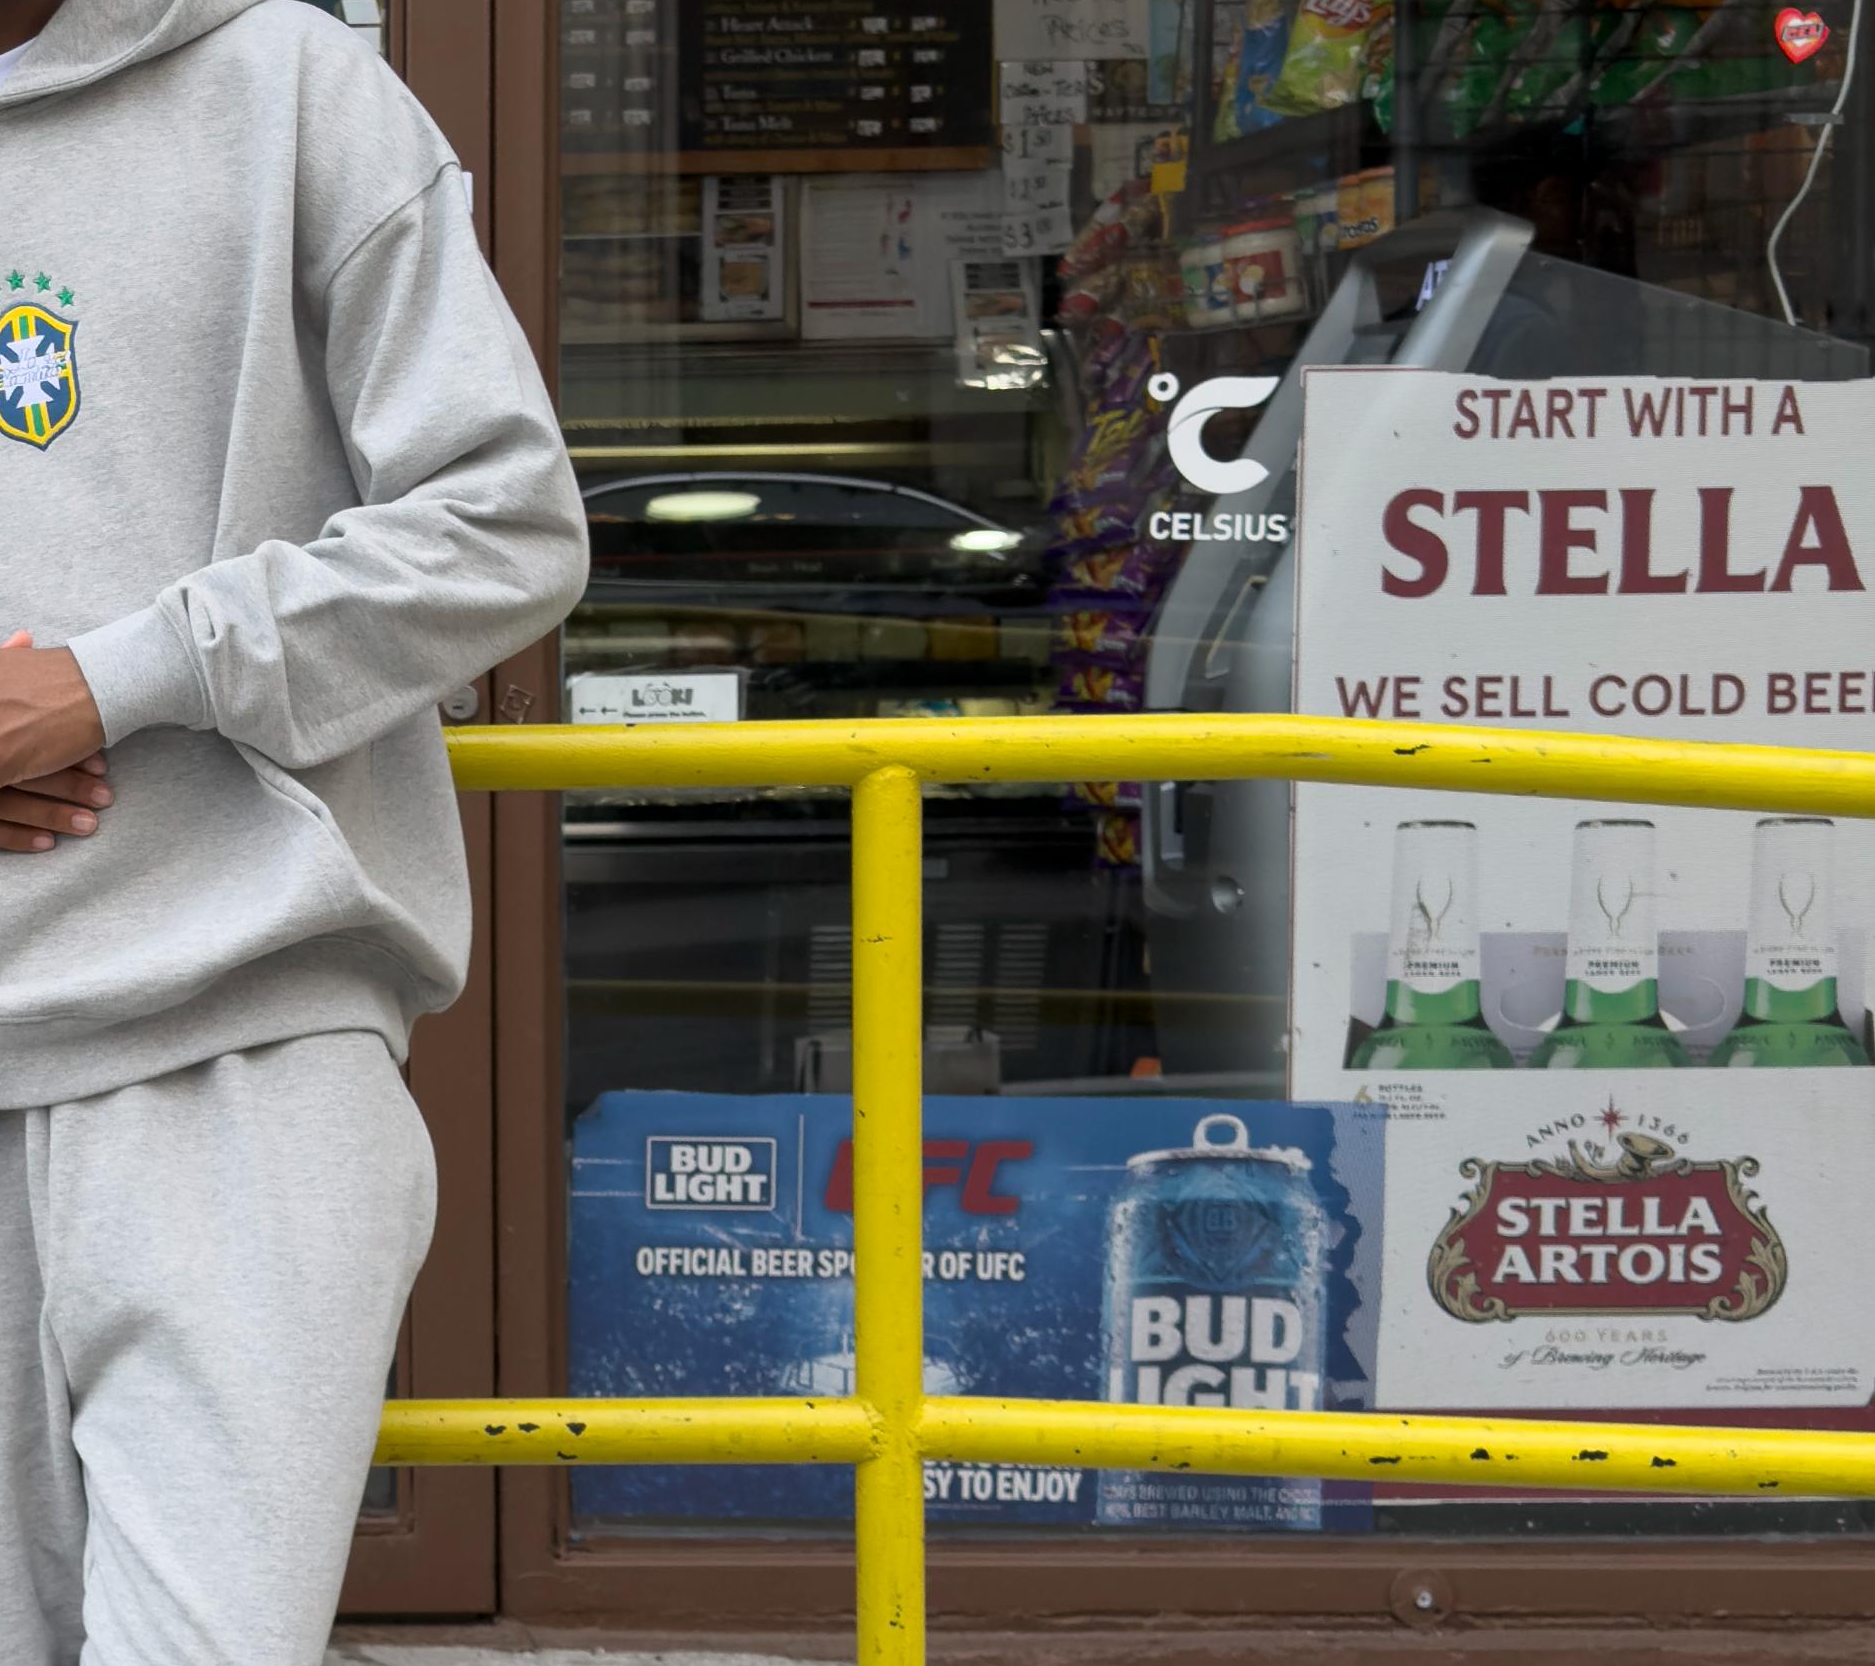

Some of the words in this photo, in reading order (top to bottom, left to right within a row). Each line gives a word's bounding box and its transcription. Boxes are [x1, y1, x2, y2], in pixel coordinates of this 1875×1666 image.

[1453, 387, 1607, 440] START
[1623, 386, 1755, 437] WITH
[1770, 386, 1806, 436] A
[1149, 511, 1287, 542] CELSIUS
[1381, 485, 1867, 598] STELLA
[1335, 676, 1422, 718] WE
[1440, 675, 1570, 718] SELL
[1588, 673, 1748, 717] COLD
[1525, 1113, 1586, 1149] ANNO
[670, 1144, 753, 1174] BUD
[654, 1174, 768, 1203] LIGHT
[1495, 1196, 1723, 1238] STELLA
[636, 1246, 747, 1276] OFFICIAL
[751, 1248, 814, 1277] BEER
[939, 1252, 973, 1279] OF
[976, 1253, 1026, 1281] UFC
[1492, 1243, 1724, 1285] ARTOIS
[1130, 1295, 1303, 1364] BUD
[1545, 1328, 1582, 1344] 600
[1596, 1328, 1668, 1343] YEARS
[1531, 1344, 1615, 1371] Brewing
[958, 1470, 993, 1501] TO
[996, 1471, 1083, 1503] ENJOY
